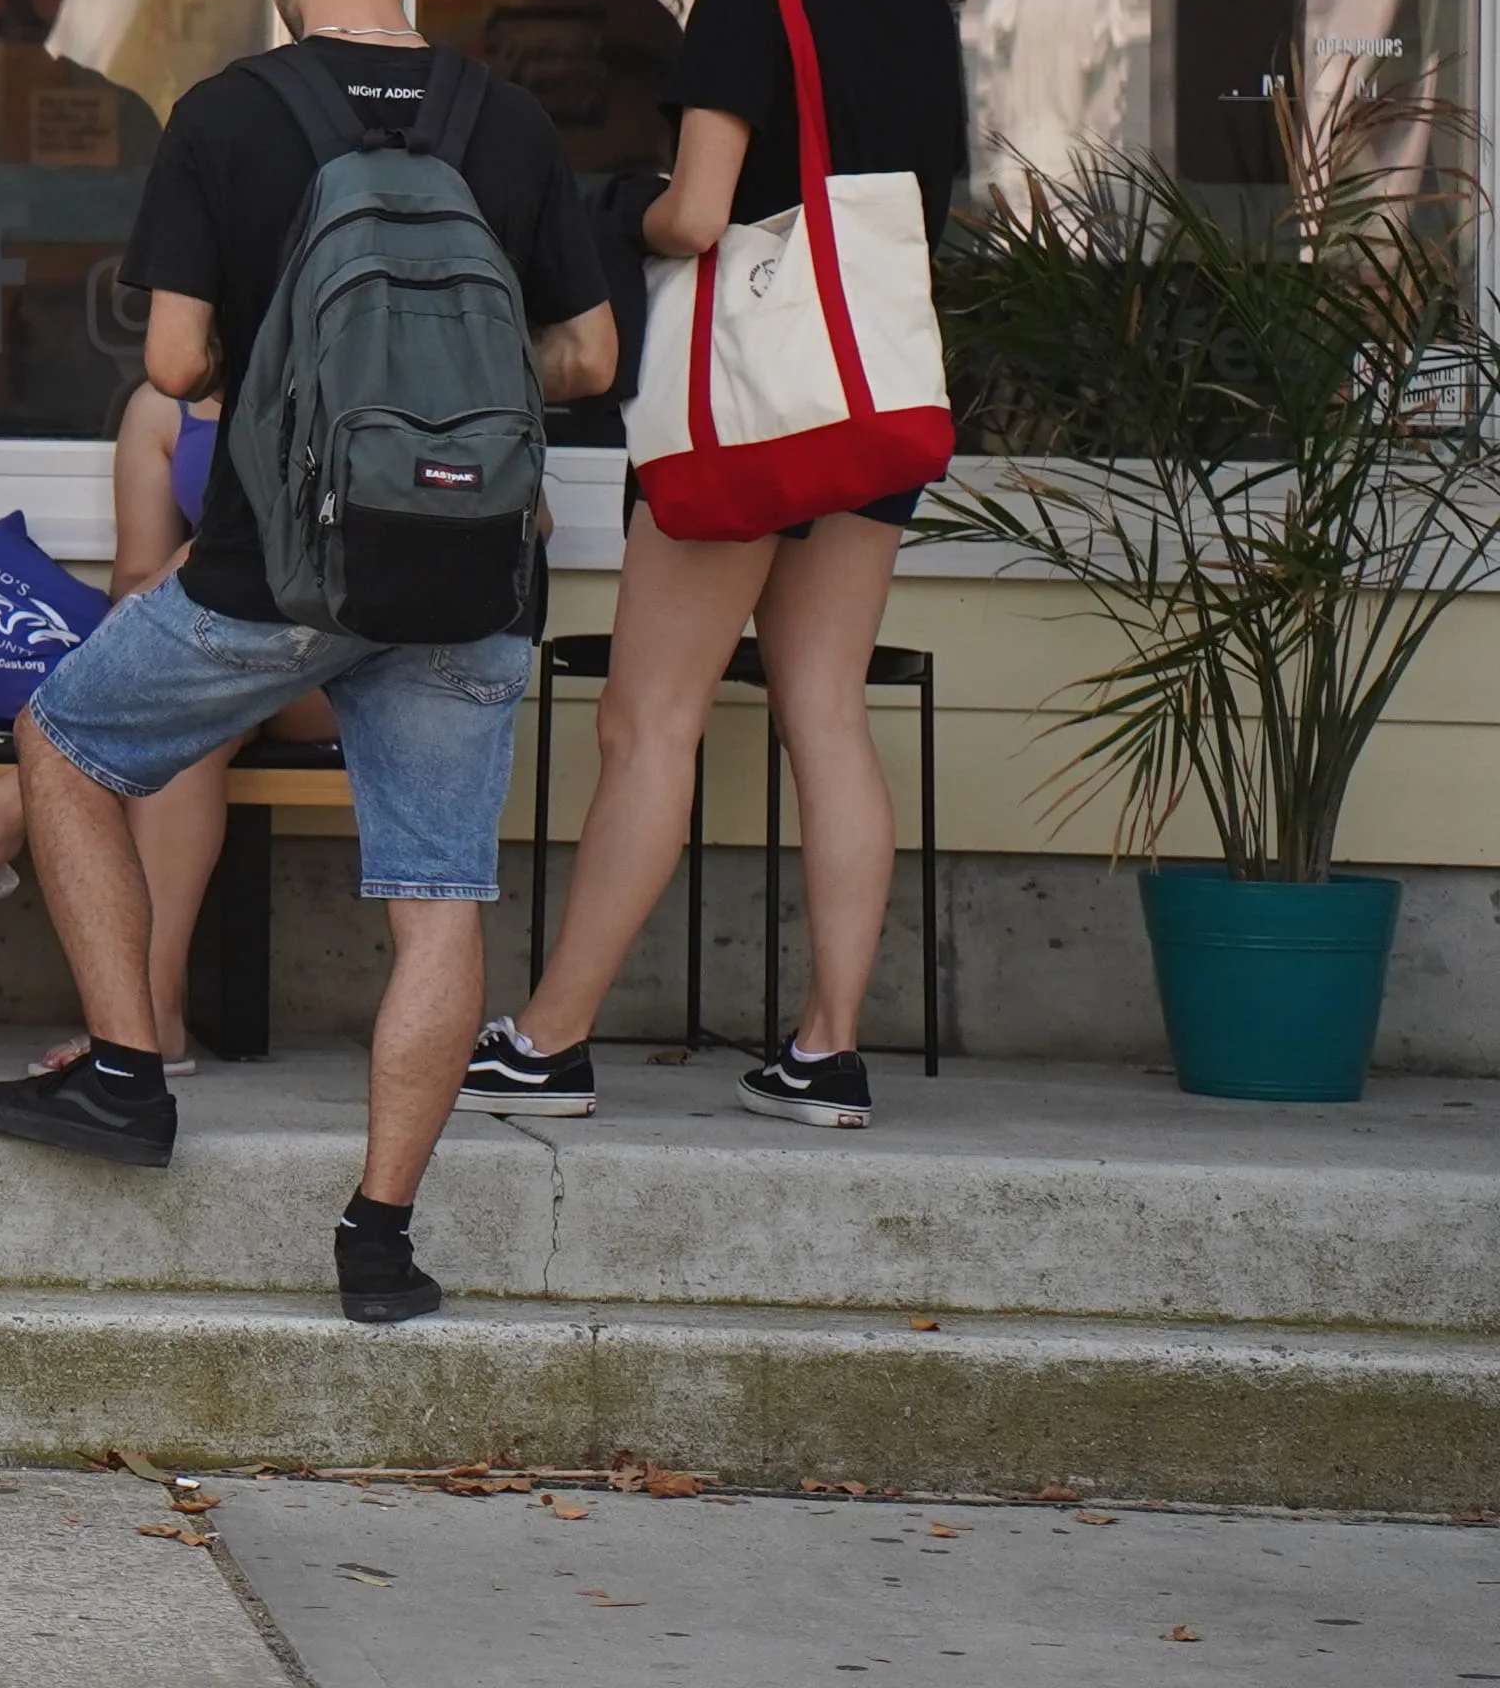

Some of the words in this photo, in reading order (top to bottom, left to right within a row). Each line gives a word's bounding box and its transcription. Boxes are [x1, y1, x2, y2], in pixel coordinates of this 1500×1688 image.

[1316, 38, 1352, 57] OPEN
[1356, 38, 1403, 58] HOURS
[347, 84, 382, 99] NIGHT
[384, 87, 426, 100] ADDIC
[425, 468, 475, 483] EASTPAK
